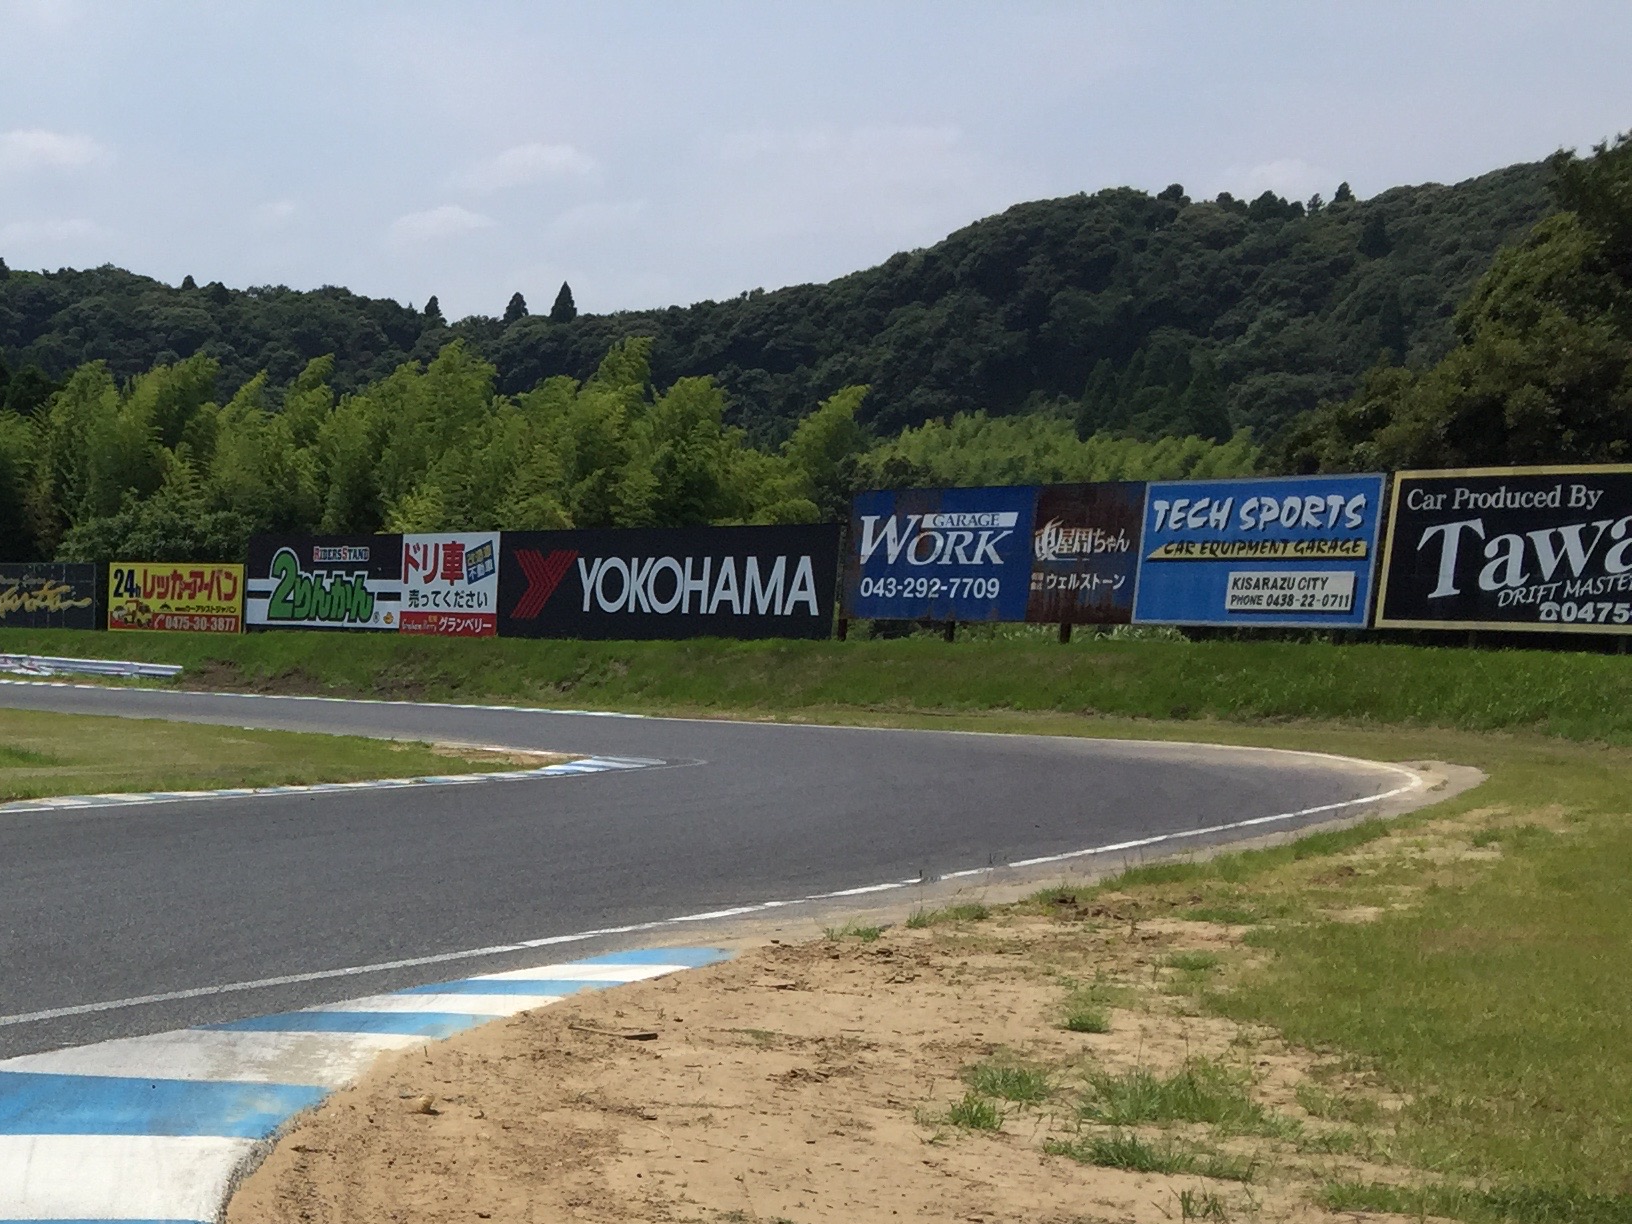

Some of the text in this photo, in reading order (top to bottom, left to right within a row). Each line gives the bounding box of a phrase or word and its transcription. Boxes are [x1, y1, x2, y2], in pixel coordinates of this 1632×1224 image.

[1406, 484, 1604, 511] Car Produced By
[932, 513, 1000, 527] GARAGE
[1153, 493, 1367, 533] TECH SPORTS
[860, 514, 1014, 566] WORK
[1164, 538, 1363, 558] CAR EQUIPMENT GARAGE
[403, 540, 465, 586] ドリ車
[268, 548, 375, 622] 2りんかん
[577, 555, 819, 616] YOKOHAMA
[860, 577, 1000, 599] 043-292-7709
[1046, 572, 1126, 590] ウェルストーン
[1231, 577, 1329, 591] KISARAZU CITY
[1498, 574, 1632, 607] DRIFT MASTE
[408, 589, 488, 609] 売ってください
[1230, 593, 1351, 608] PHONE 0438-22-0711
[165, 615, 236, 632] 0475-30-3877
[1561, 601, 1632, 624] 0475
[438, 616, 492, 633] グランベリー
